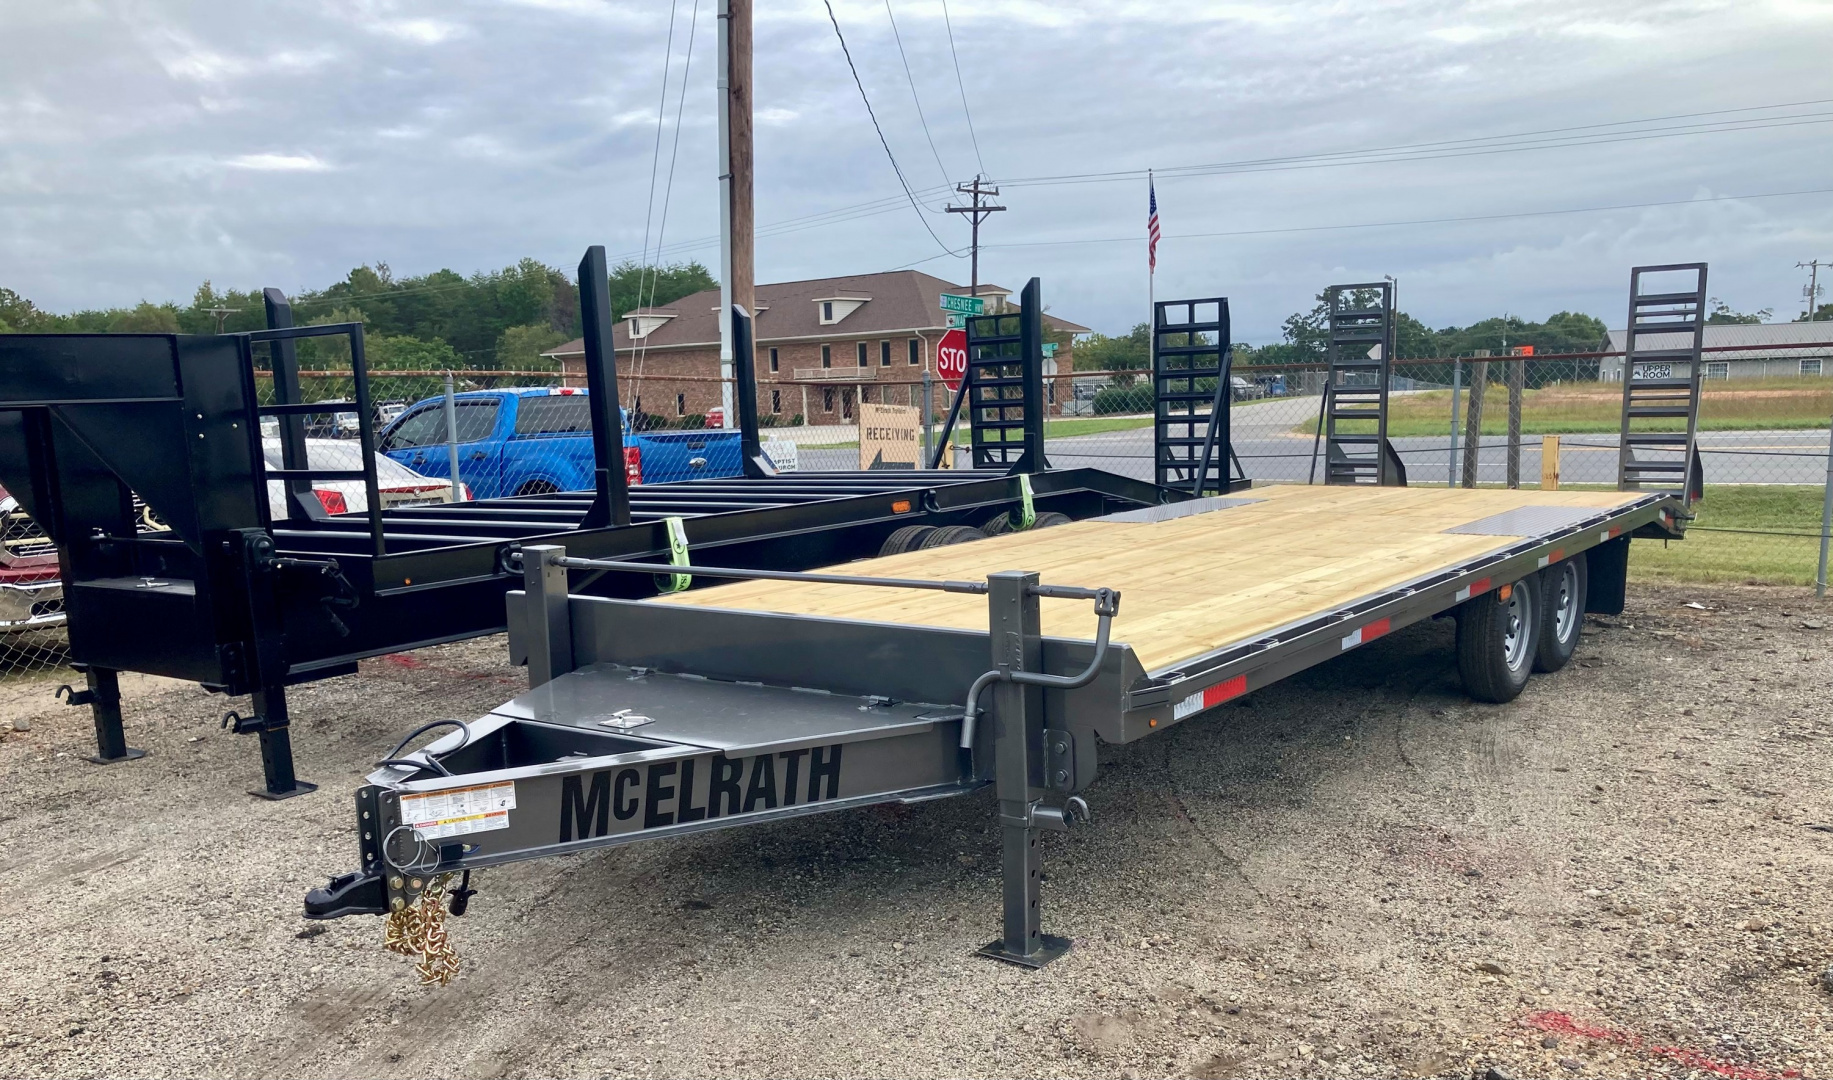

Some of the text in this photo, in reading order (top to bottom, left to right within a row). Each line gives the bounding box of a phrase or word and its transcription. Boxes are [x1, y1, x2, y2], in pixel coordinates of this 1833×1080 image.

[947, 297, 972, 311] CHESNEE
[940, 347, 967, 373] STO
[1642, 364, 1671, 372] UPPER
[1642, 371, 1671, 379] ROOM
[866, 427, 915, 441] RECEIVING
